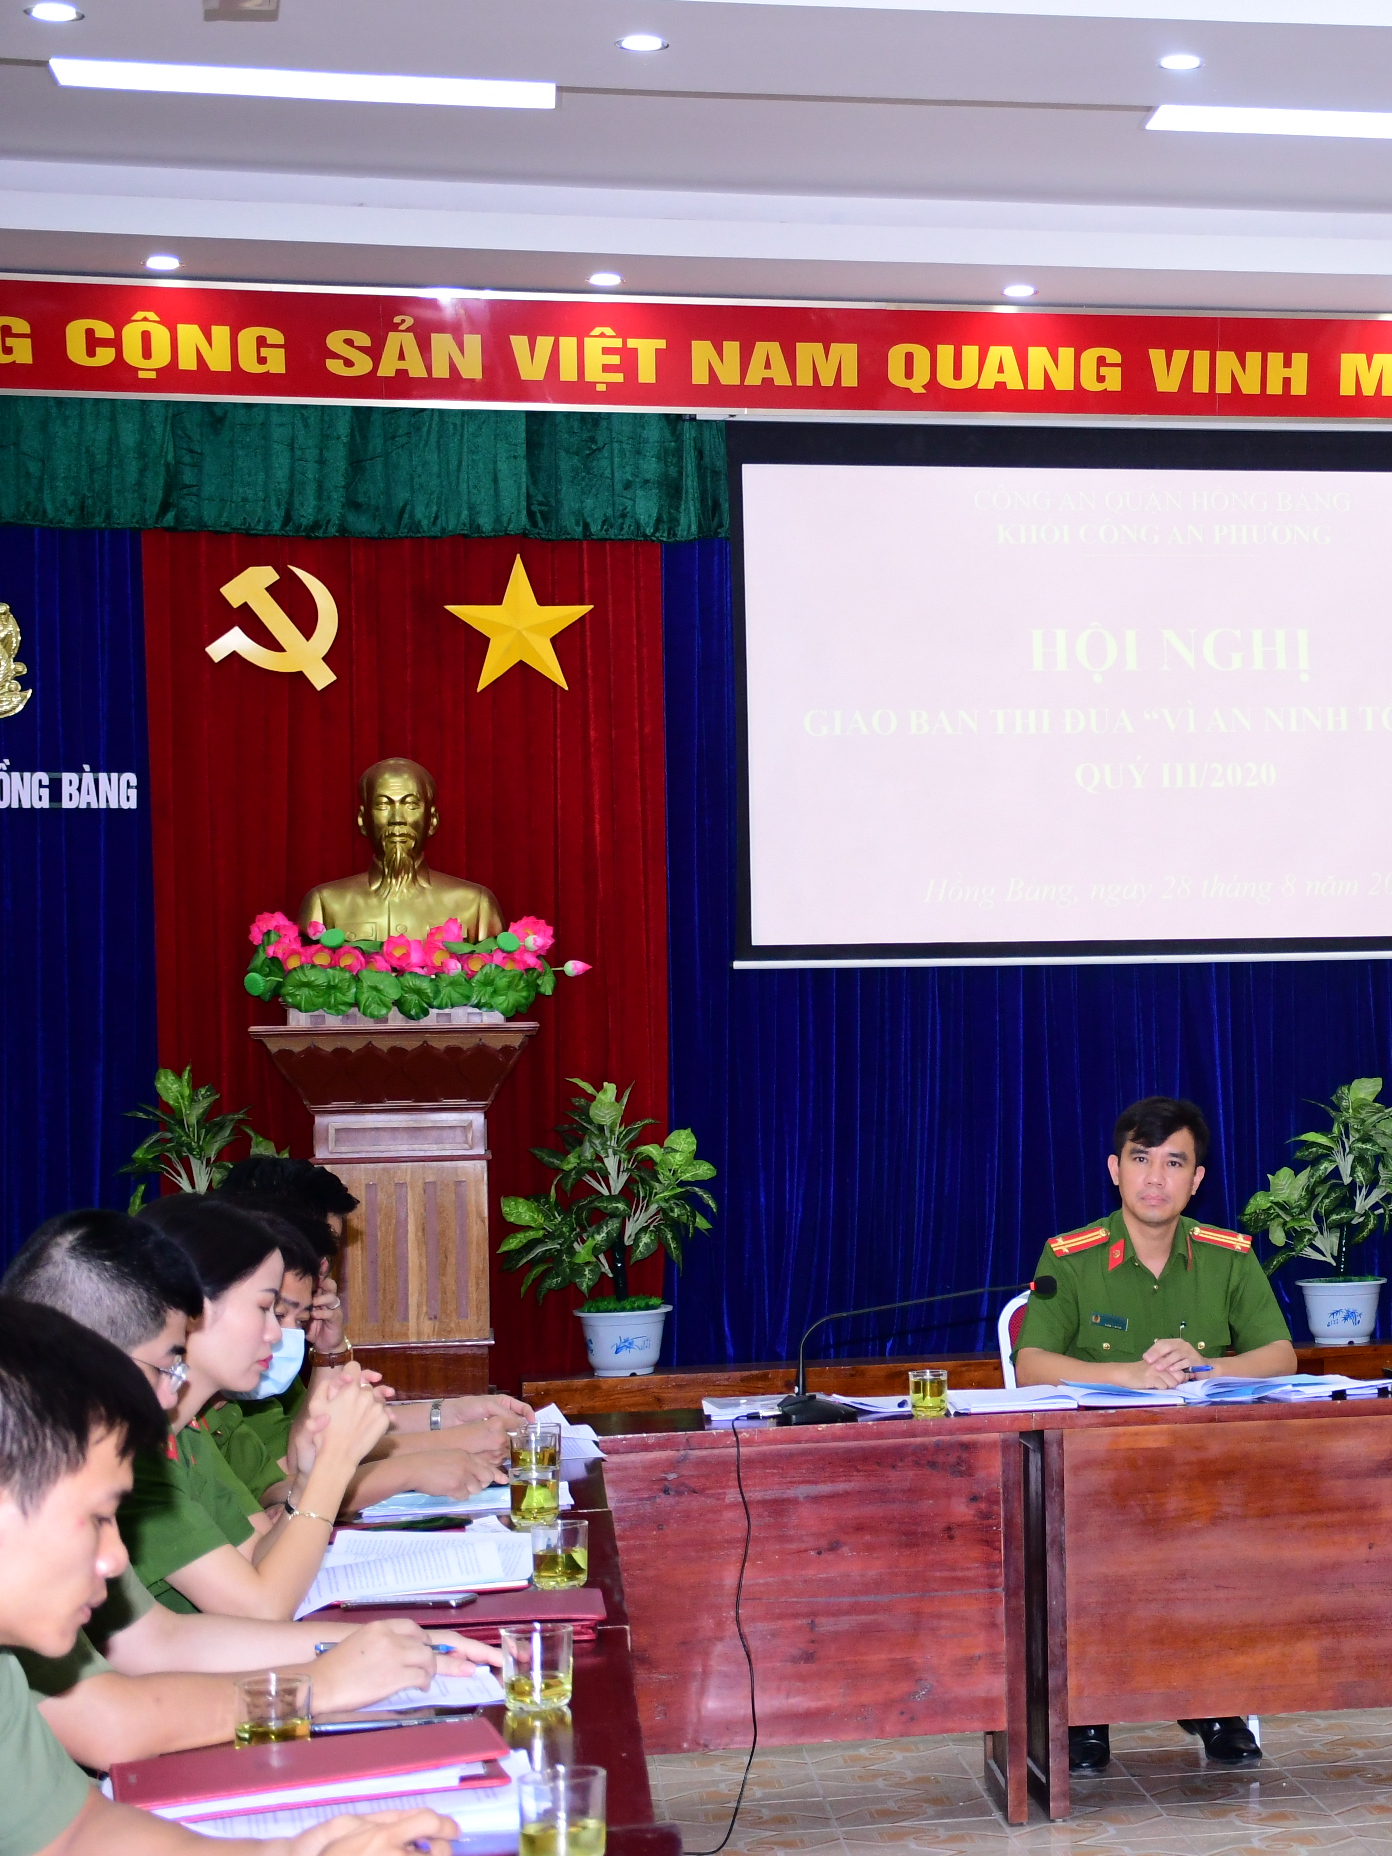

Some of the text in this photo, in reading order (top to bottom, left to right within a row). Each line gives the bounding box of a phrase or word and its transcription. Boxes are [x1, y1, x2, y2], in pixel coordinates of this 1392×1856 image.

[66, 312, 287, 381] CỘNG
[326, 316, 484, 384] SẢN
[510, 327, 668, 393] VIỆT
[692, 341, 859, 388] NAM
[888, 343, 1123, 395] QUANG
[1149, 350, 1309, 397] VINH
[973, 484, 1052, 511] CÔNG
[1058, 490, 1097, 511] AN
[1078, 517, 1161, 545] CÔNG
[1168, 523, 1205, 545] AN
[1029, 621, 1312, 684] HỘI NGHỊ
[802, 706, 900, 738] GIAO
[909, 706, 981, 737] BAN
[990, 705, 1053, 737] THI
[1063, 706, 1136, 737] ĐUA
[1206, 705, 1254, 735] AN
[1264, 705, 1349, 734] NINH
[62, 764, 138, 809] BÀNG
[1074, 754, 1279, 794] QUÝ III/2020
[1161, 874, 1193, 901] 28
[1281, 872, 1299, 899] 8
[1305, 874, 1360, 898] năm
